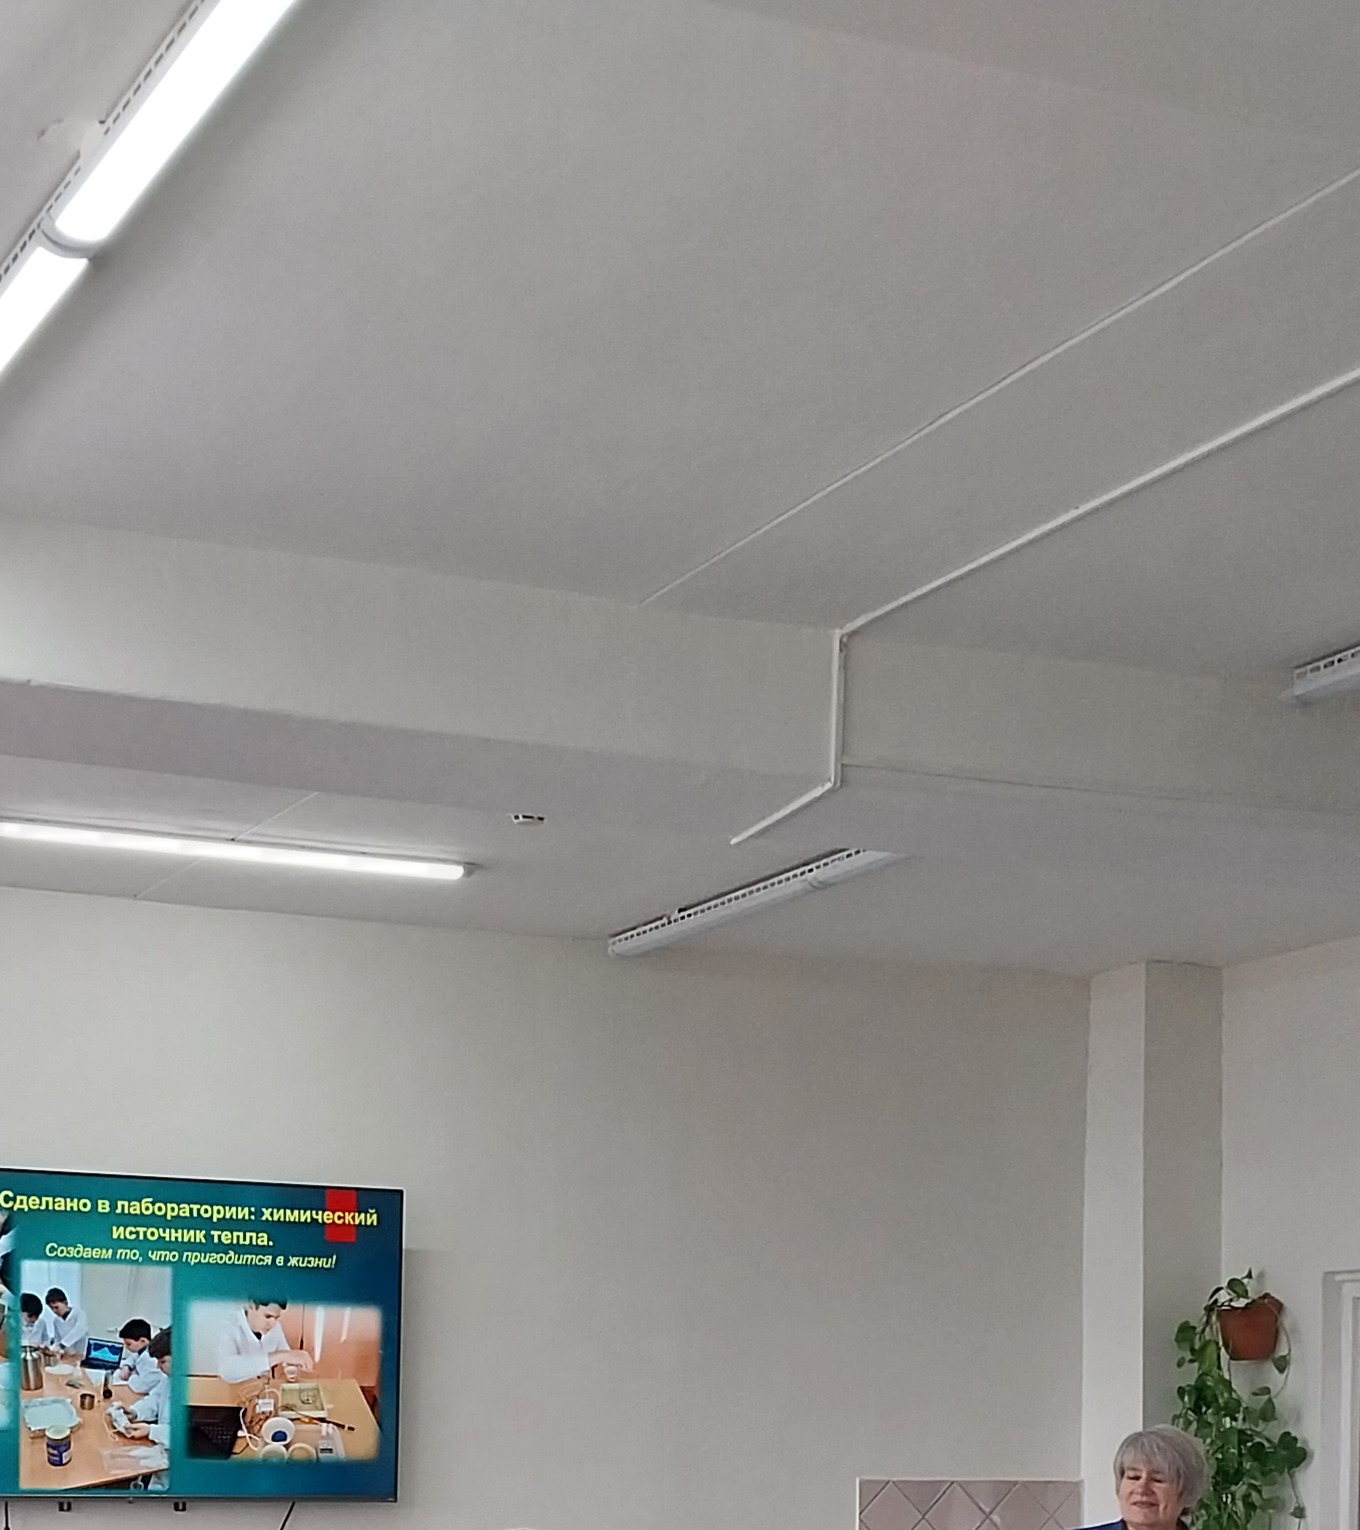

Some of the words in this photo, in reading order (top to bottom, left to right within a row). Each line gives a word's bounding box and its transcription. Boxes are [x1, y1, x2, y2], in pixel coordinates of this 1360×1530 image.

[97, 1199, 110, 1213] в
[115, 1198, 256, 1221] лаборатории:
[261, 1207, 378, 1226] химический
[112, 1225, 206, 1243] источник
[211, 1231, 274, 1246] тепла.
[45, 1242, 112, 1260] Создаем
[116, 1248, 143, 1263] то,
[147, 1250, 179, 1262] что
[182, 1250, 272, 1266] пригодится
[275, 1255, 284, 1266] в
[287, 1254, 337, 1269] жизни!
